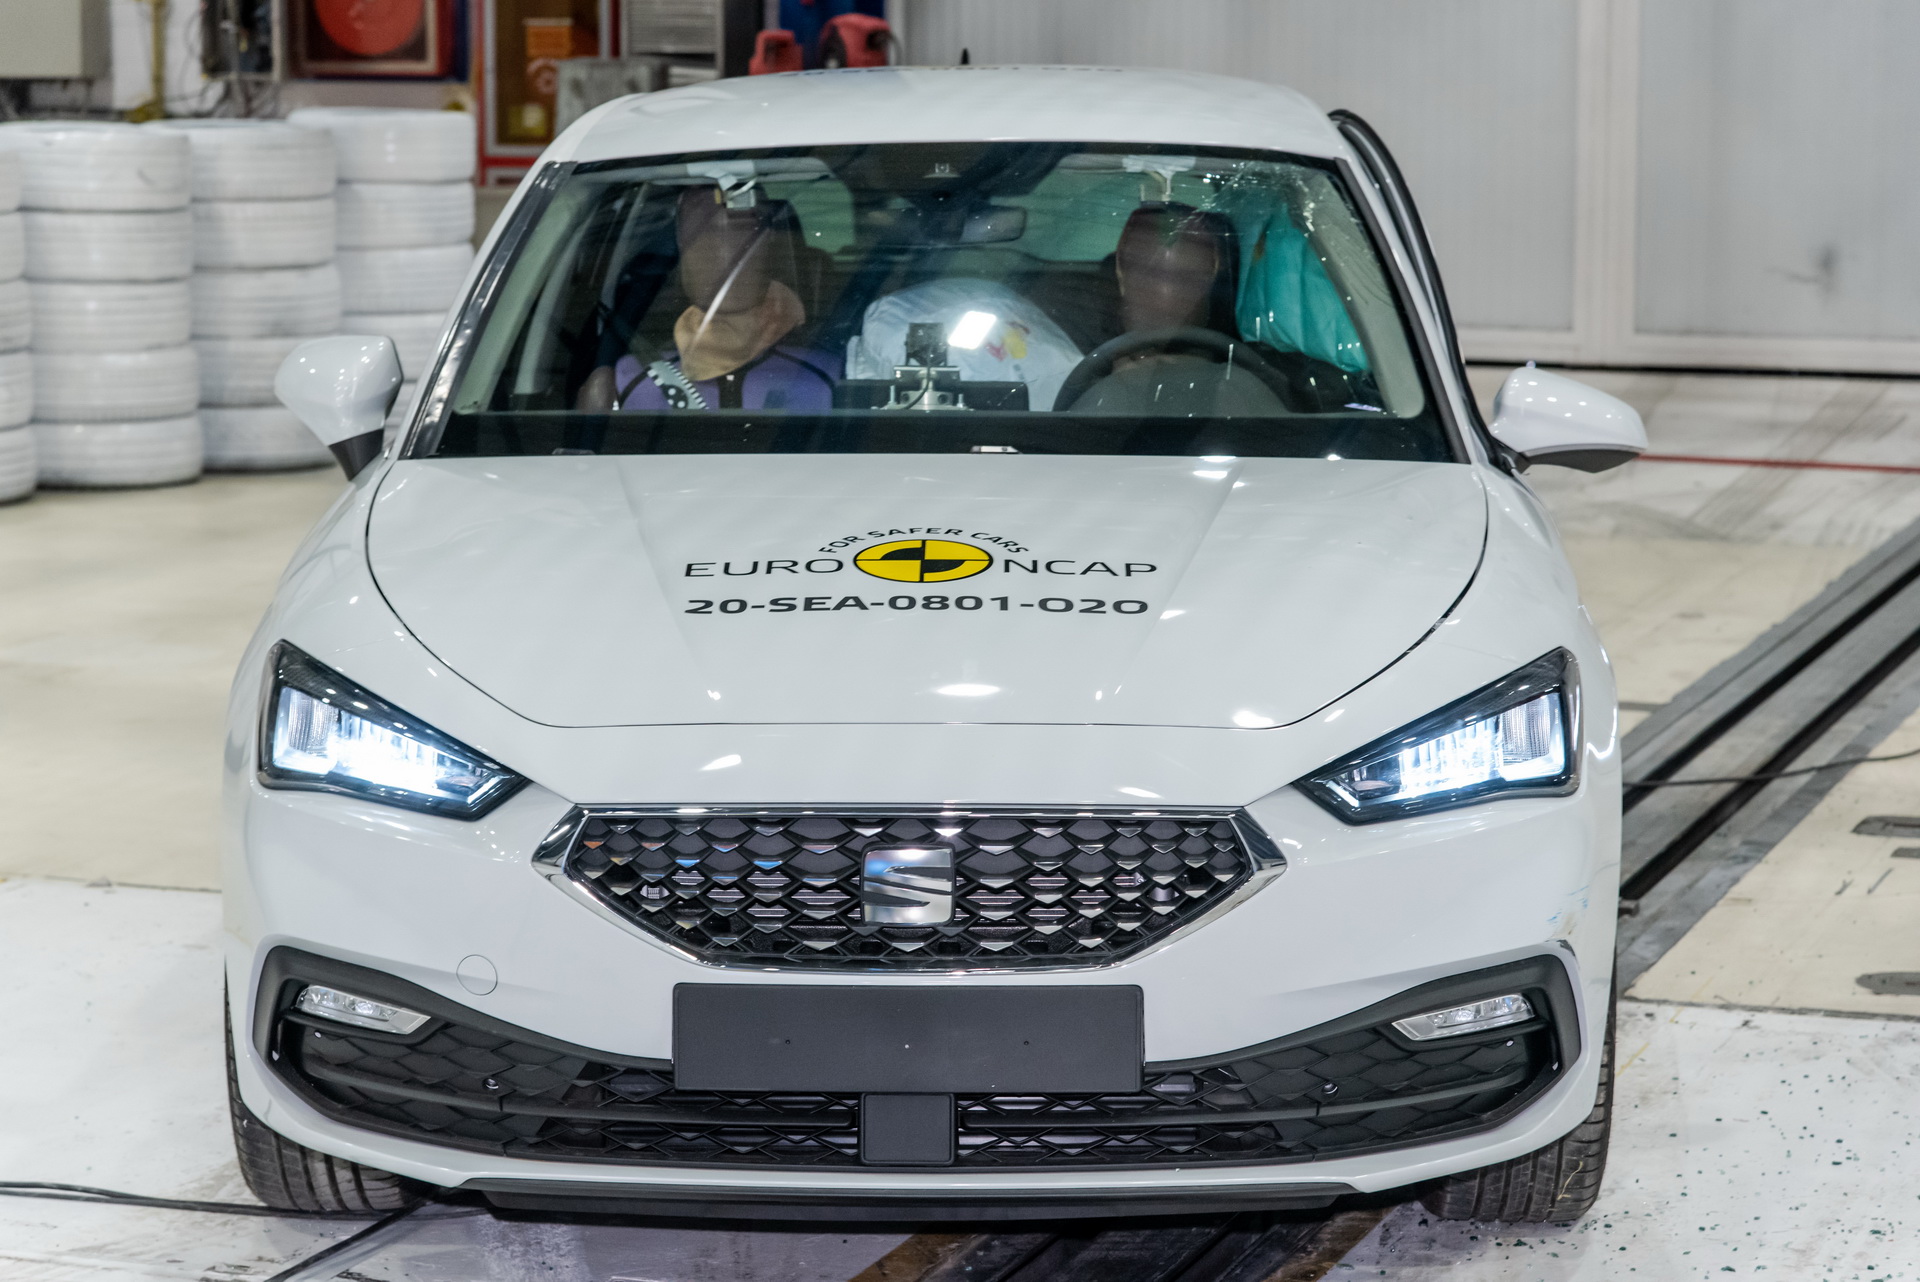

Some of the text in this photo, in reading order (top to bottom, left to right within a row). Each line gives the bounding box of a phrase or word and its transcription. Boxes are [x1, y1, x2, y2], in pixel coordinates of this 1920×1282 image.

[818, 527, 1029, 554] FOR SAFER CARS
[684, 558, 1158, 577] EURO NCAP
